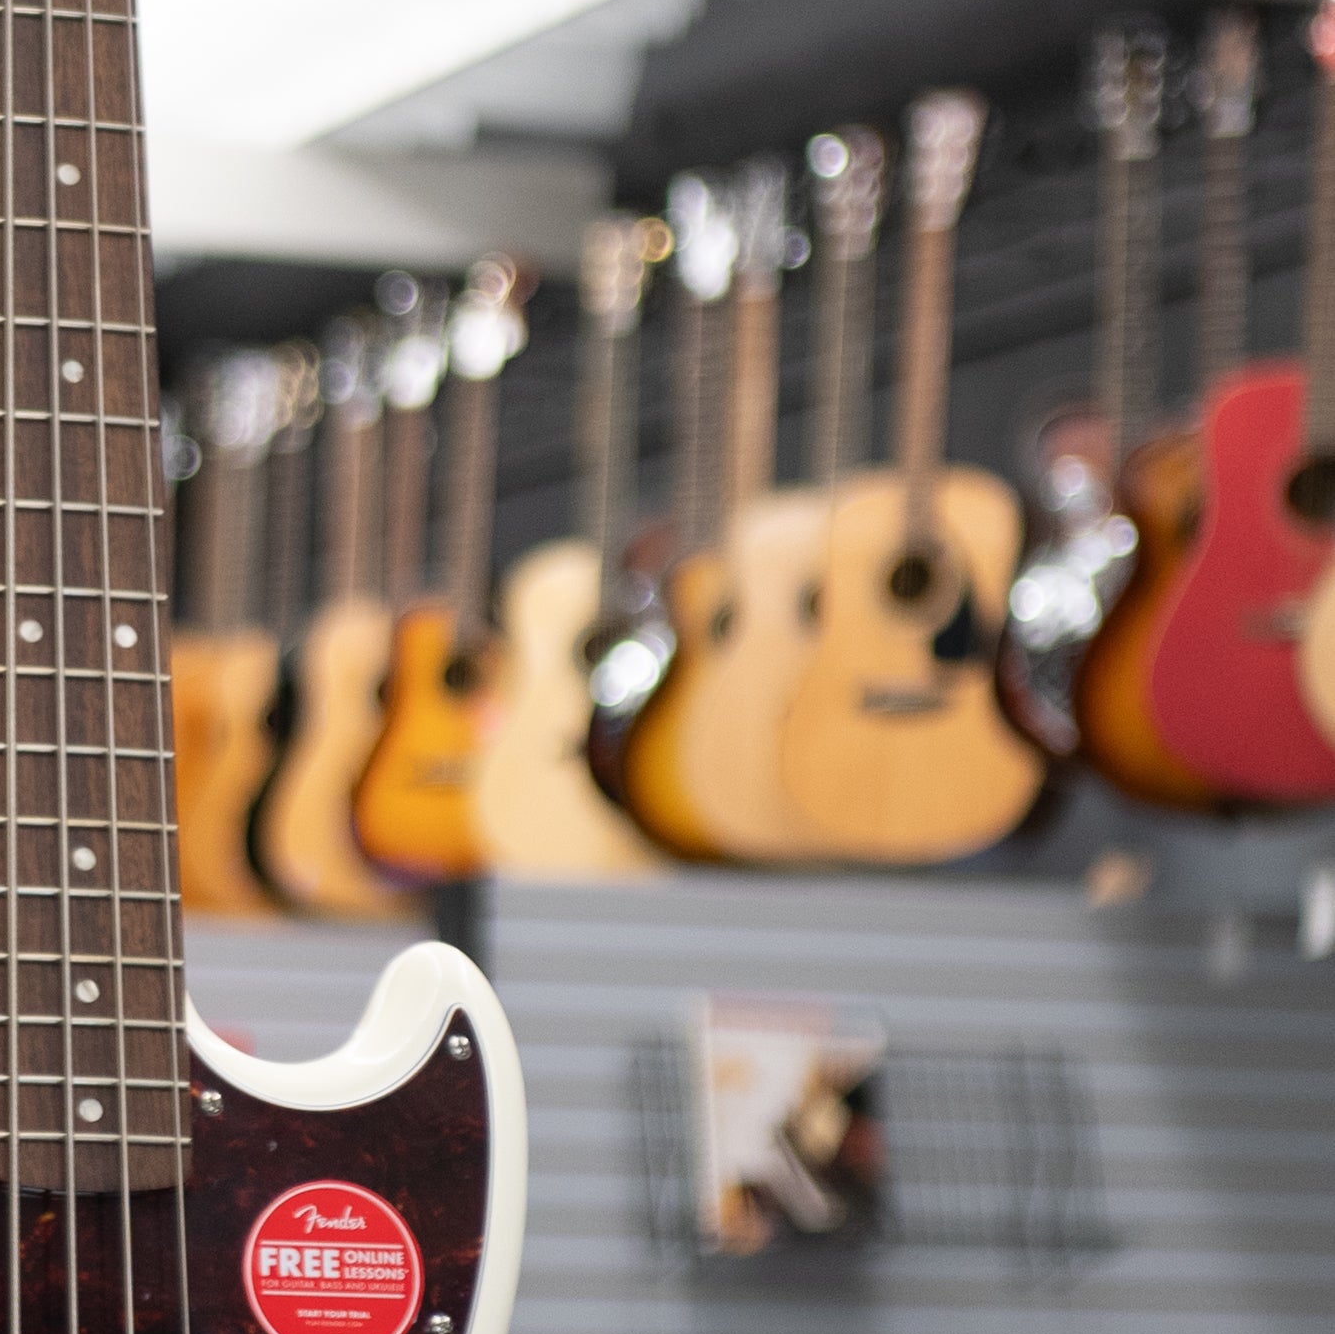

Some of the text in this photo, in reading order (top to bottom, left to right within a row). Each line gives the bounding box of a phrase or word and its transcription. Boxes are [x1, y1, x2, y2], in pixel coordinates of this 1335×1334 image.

[293, 1204, 367, 1234] Fender
[259, 1247, 341, 1279] FREE
[343, 1250, 404, 1265] ONLINE
[261, 1279, 279, 1287] FOR
[320, 1281, 343, 1289] BASS
[345, 1282, 365, 1290] AND
